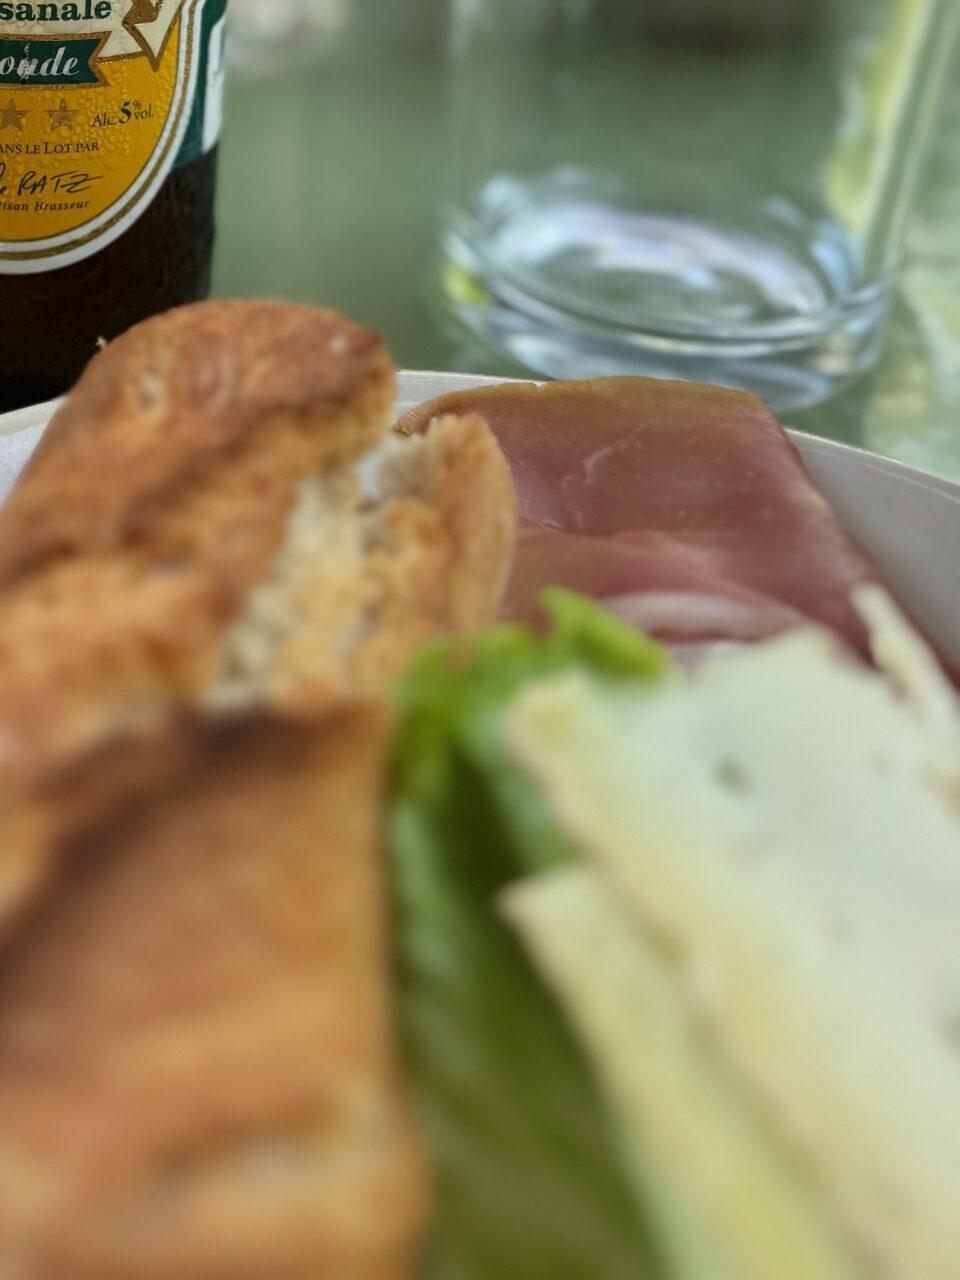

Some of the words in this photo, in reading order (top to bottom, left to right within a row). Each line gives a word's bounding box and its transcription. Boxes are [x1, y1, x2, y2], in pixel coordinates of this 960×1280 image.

[25, 143, 41, 154] LE
[44, 141, 73, 154] LOT
[76, 141, 100, 153] PAR
[34, 200, 90, 211] Brasseur
